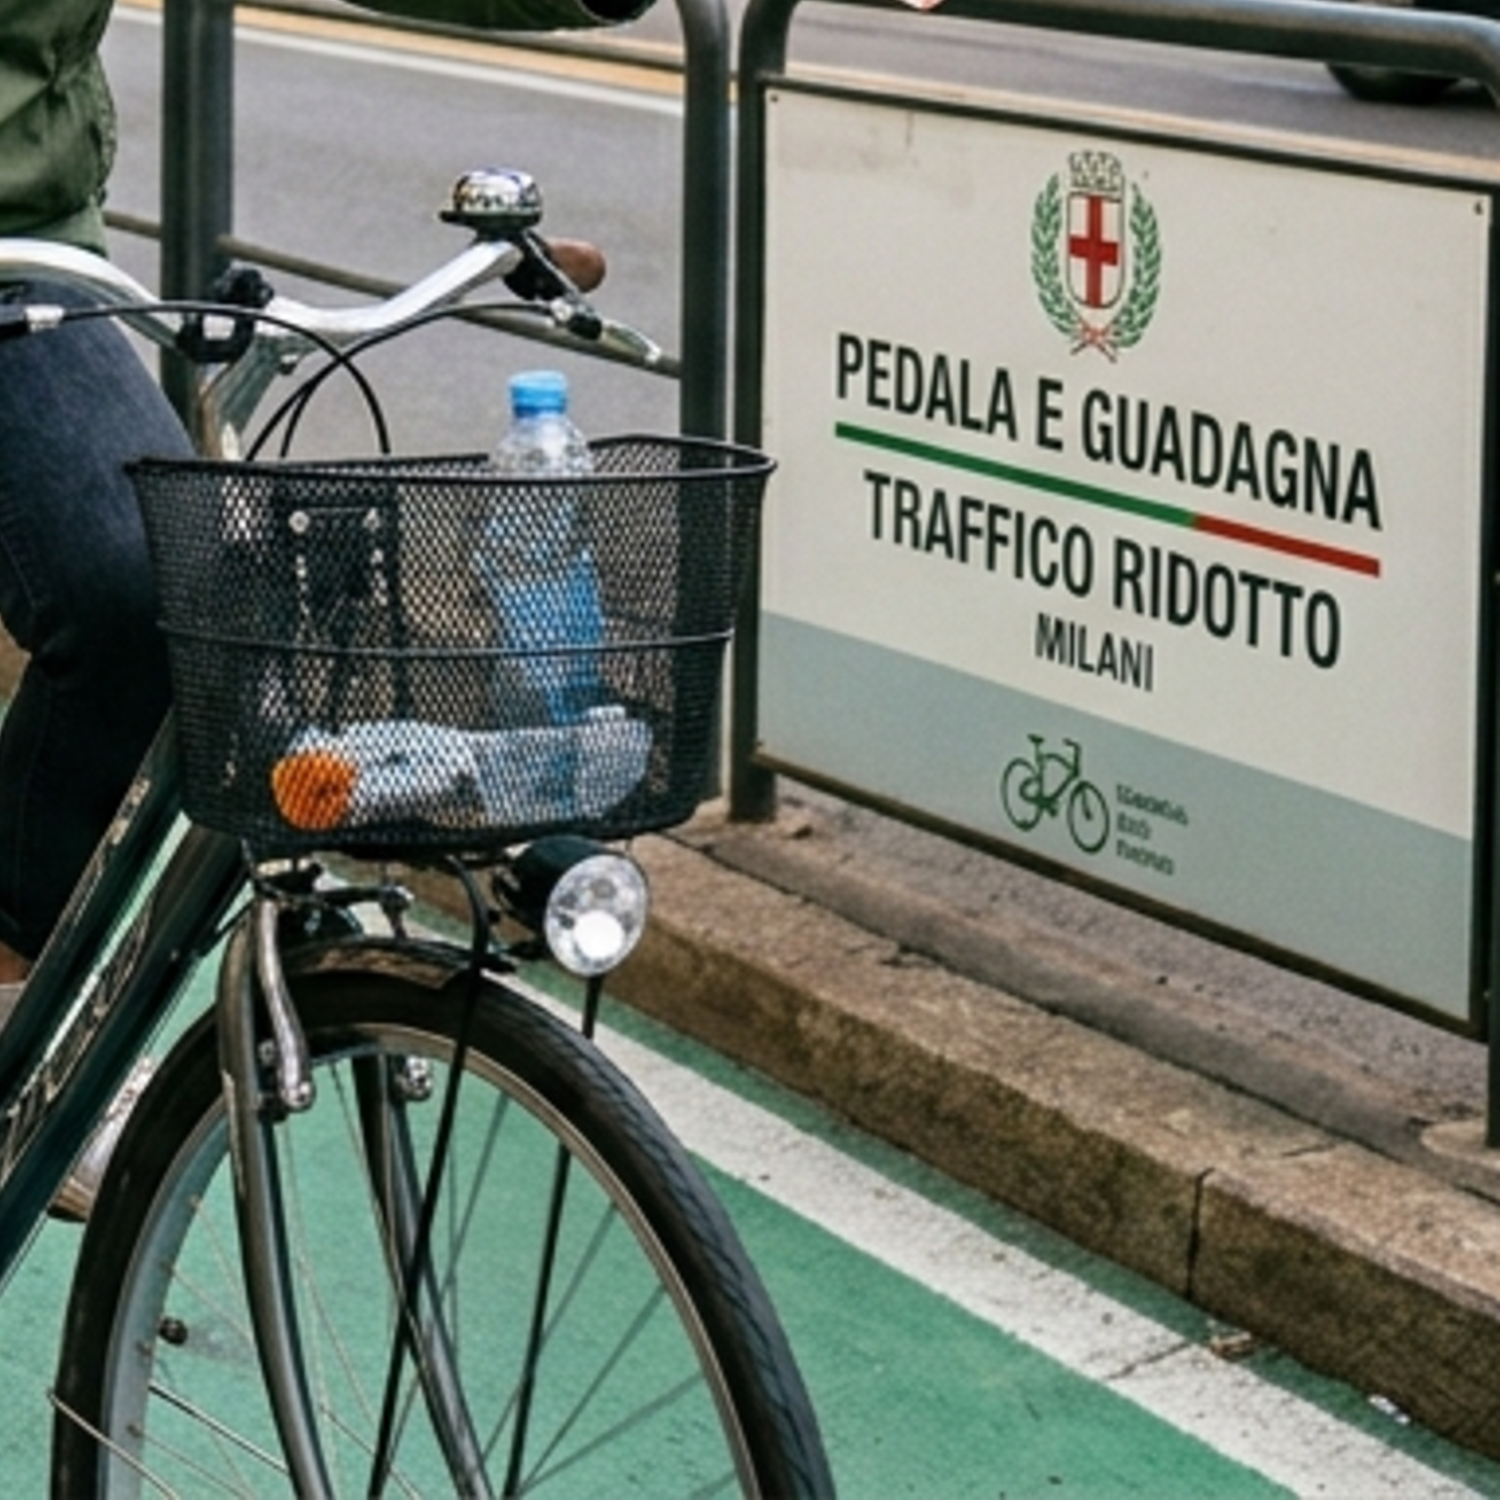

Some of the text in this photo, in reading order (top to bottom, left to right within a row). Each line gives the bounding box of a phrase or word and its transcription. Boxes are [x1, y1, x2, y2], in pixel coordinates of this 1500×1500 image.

[837, 332, 1382, 532] PEDALA E GUADAGNA
[863, 469, 1342, 670] TRAFFICO RIDOTTO
[1035, 611, 1154, 692] MILANI
